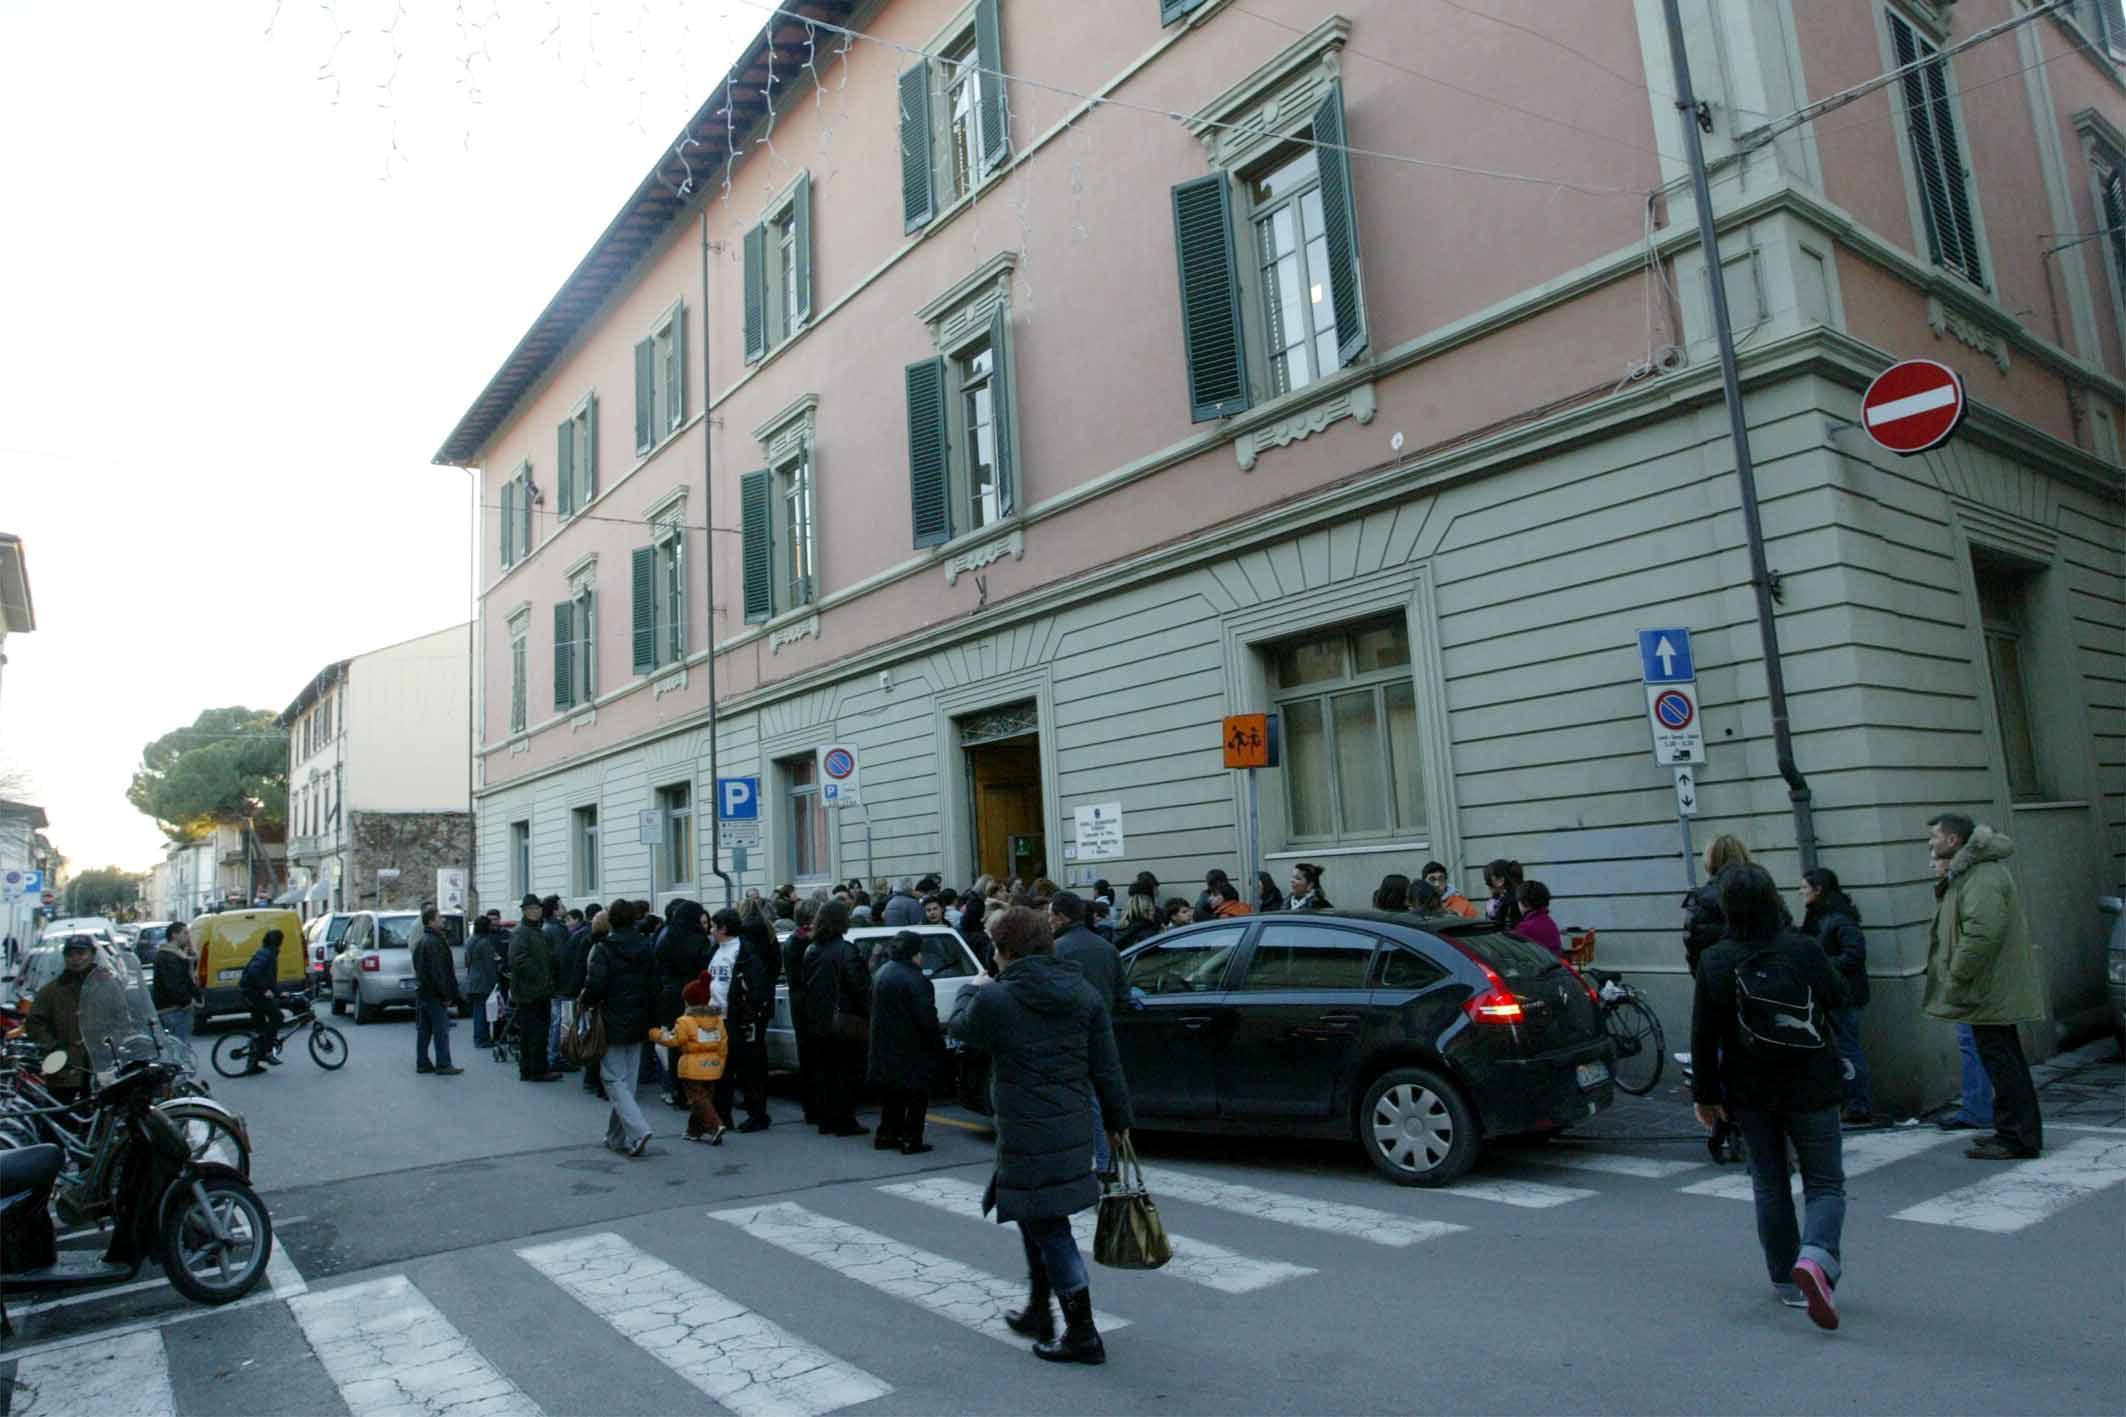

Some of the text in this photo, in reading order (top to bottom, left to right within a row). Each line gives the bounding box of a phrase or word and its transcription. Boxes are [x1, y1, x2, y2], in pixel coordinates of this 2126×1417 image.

[725, 781, 750, 816] P
[827, 786, 835, 796] P
[24, 873, 37, 890] P
